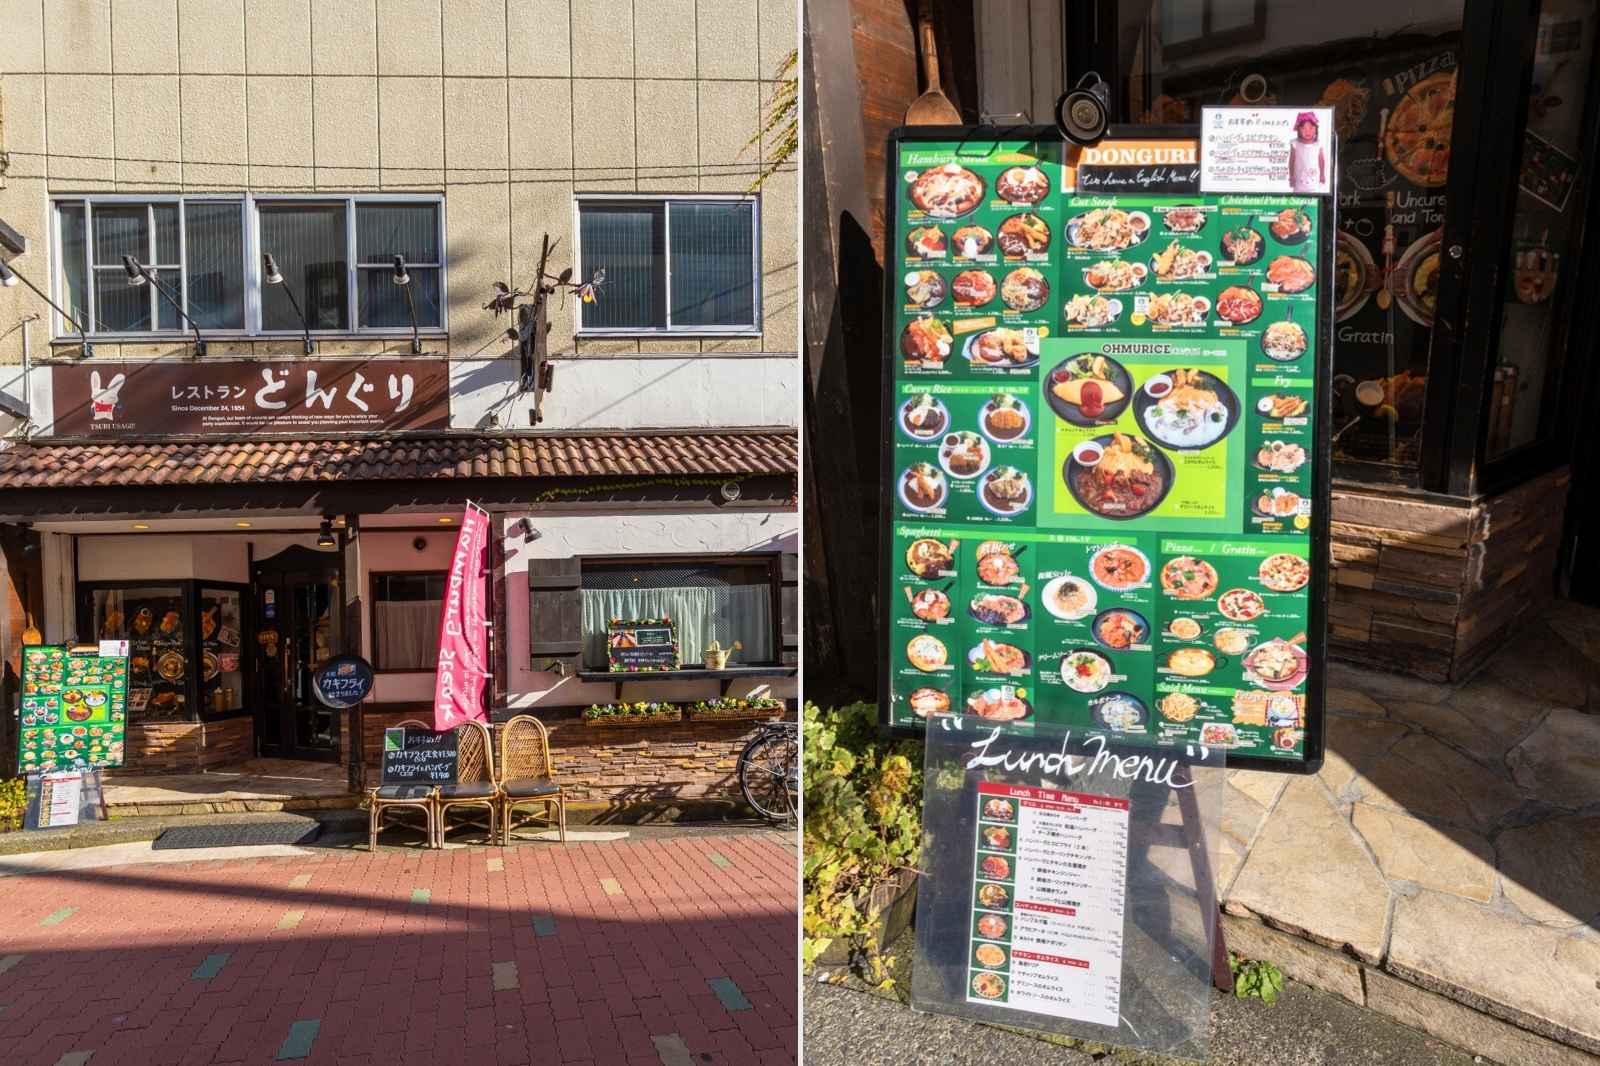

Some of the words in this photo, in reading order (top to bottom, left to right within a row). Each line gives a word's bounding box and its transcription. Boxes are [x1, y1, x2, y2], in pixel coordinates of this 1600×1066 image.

[1086, 148, 1197, 165] DONGURI
[1136, 168, 1165, 187] English
[1337, 191, 1360, 207] ork
[1396, 191, 1447, 208] Uncure
[1391, 211, 1415, 225] and
[1338, 326, 1394, 346] Gratin
[1102, 344, 1171, 354] OHMURICE
[1274, 376, 1291, 388] Fry
[172, 385, 247, 400] レストラン
[254, 367, 415, 413] どんぐり
[221, 405, 230, 413] 24,
[322, 678, 365, 690] カキフライ
[1009, 787, 1031, 797] Lunch
[1038, 791, 1055, 800] Time
